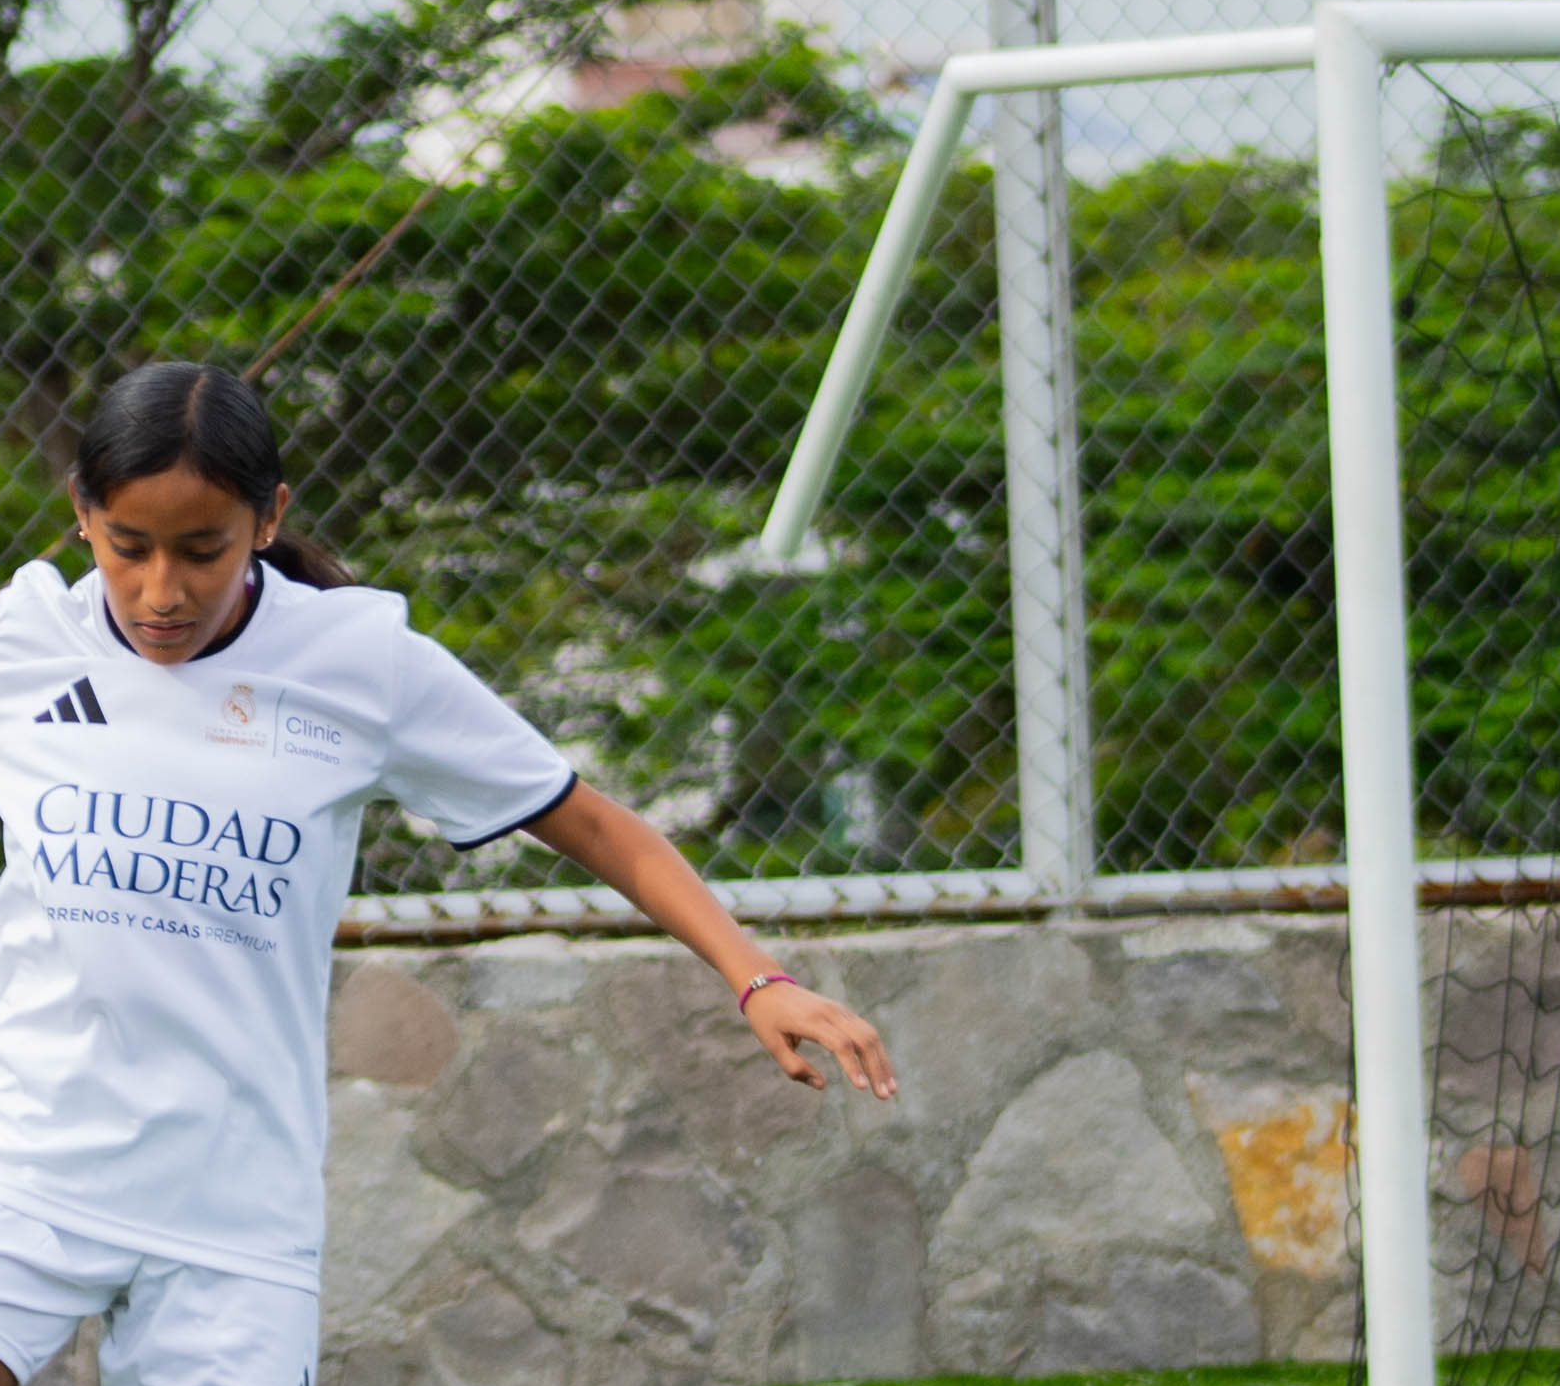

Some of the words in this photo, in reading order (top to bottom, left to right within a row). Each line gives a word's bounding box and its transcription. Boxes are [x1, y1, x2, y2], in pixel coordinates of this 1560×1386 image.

[286, 716, 341, 745] Clinic
[34, 784, 301, 865] CIUDAD
[33, 838, 290, 918] MADERAS
[42, 905, 120, 925] RRENOS
[126, 913, 136, 928] Y
[141, 917, 201, 939] CASAS
[205, 925, 277, 953] PREMIUM
